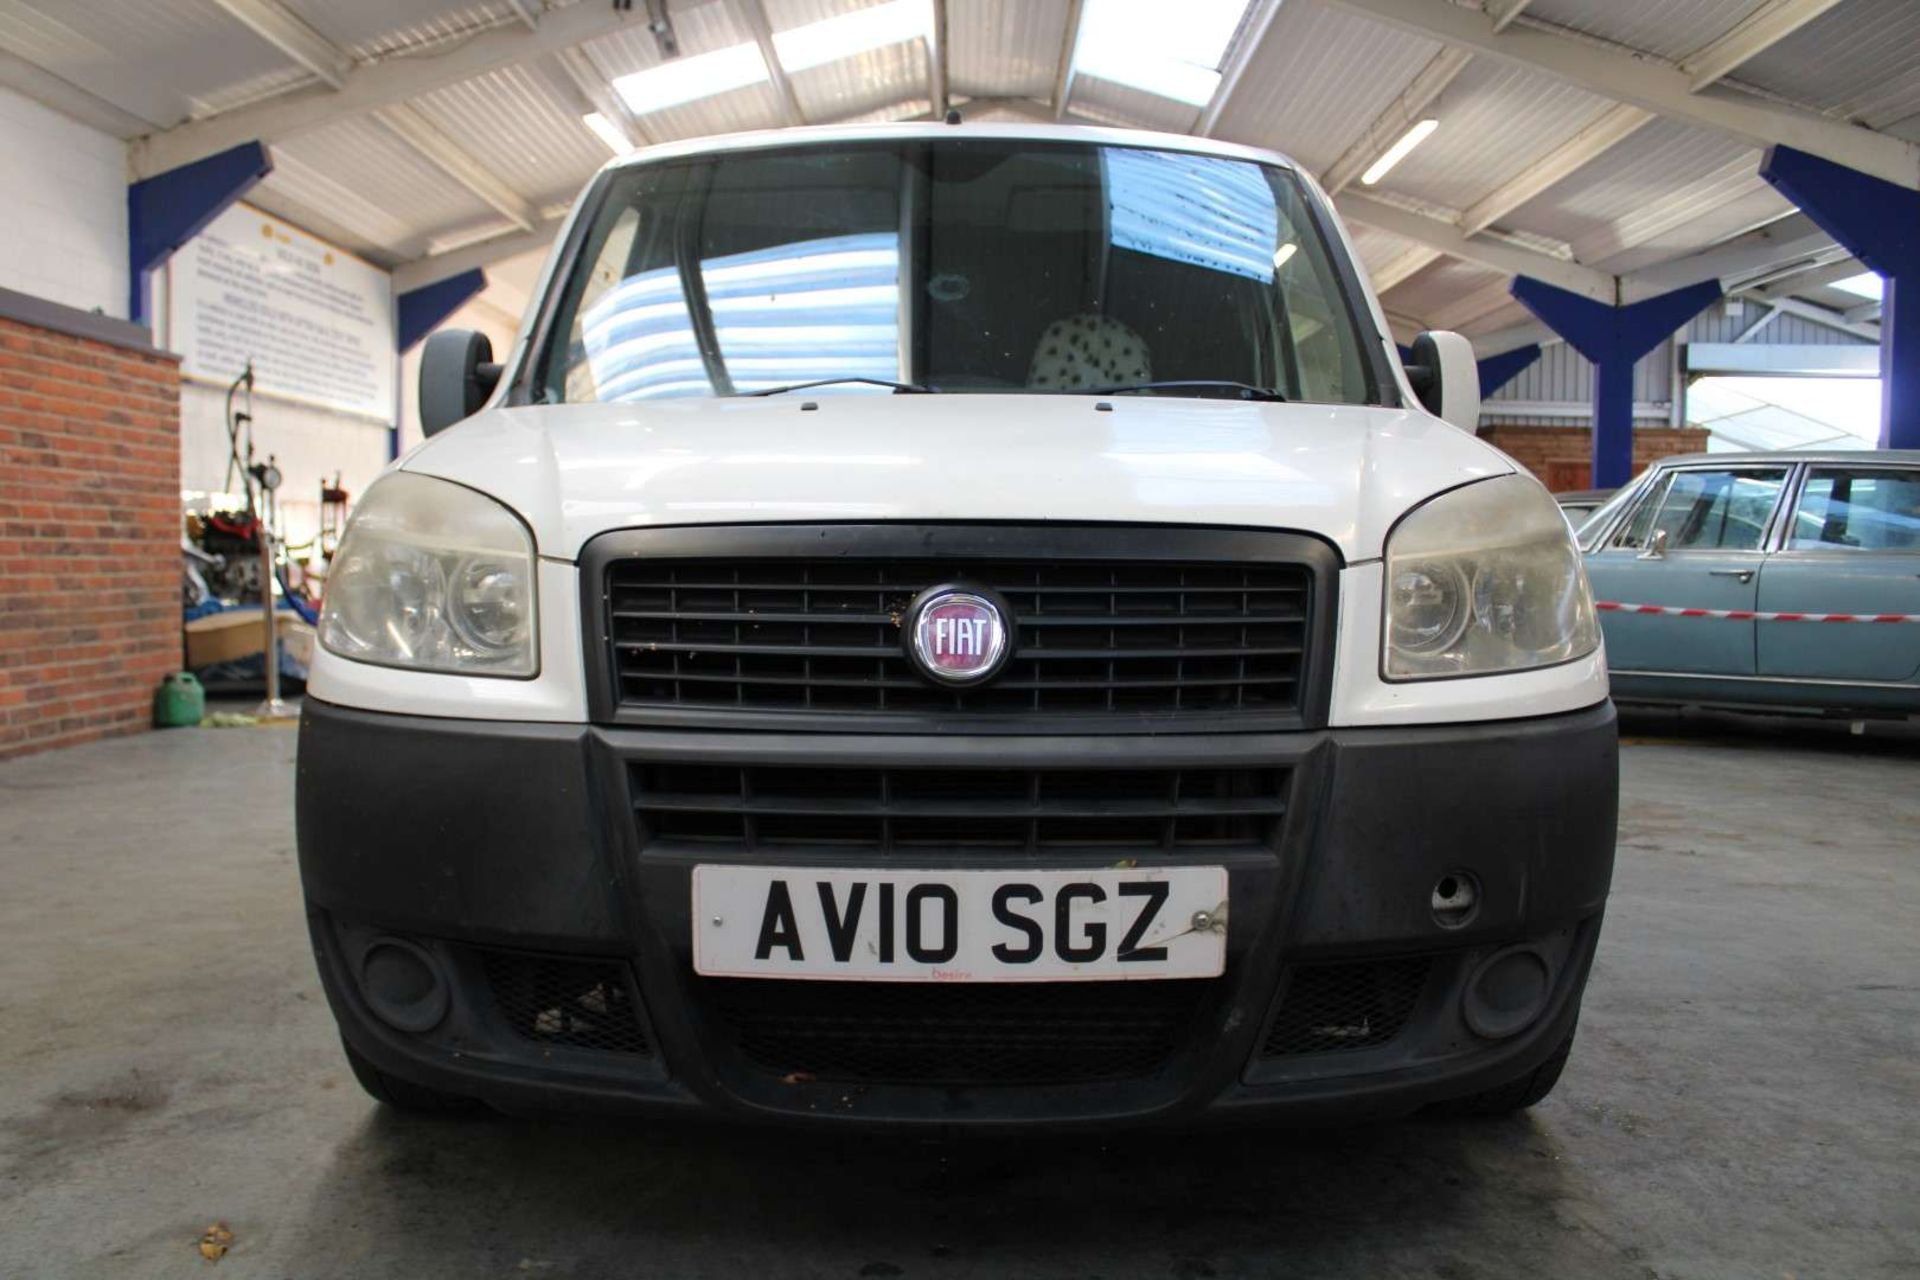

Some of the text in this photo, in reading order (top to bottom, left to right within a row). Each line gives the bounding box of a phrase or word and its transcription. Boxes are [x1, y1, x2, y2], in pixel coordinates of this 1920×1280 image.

[936, 618, 988, 655] FIAT
[754, 880, 1169, 963] AV10 SGZ
